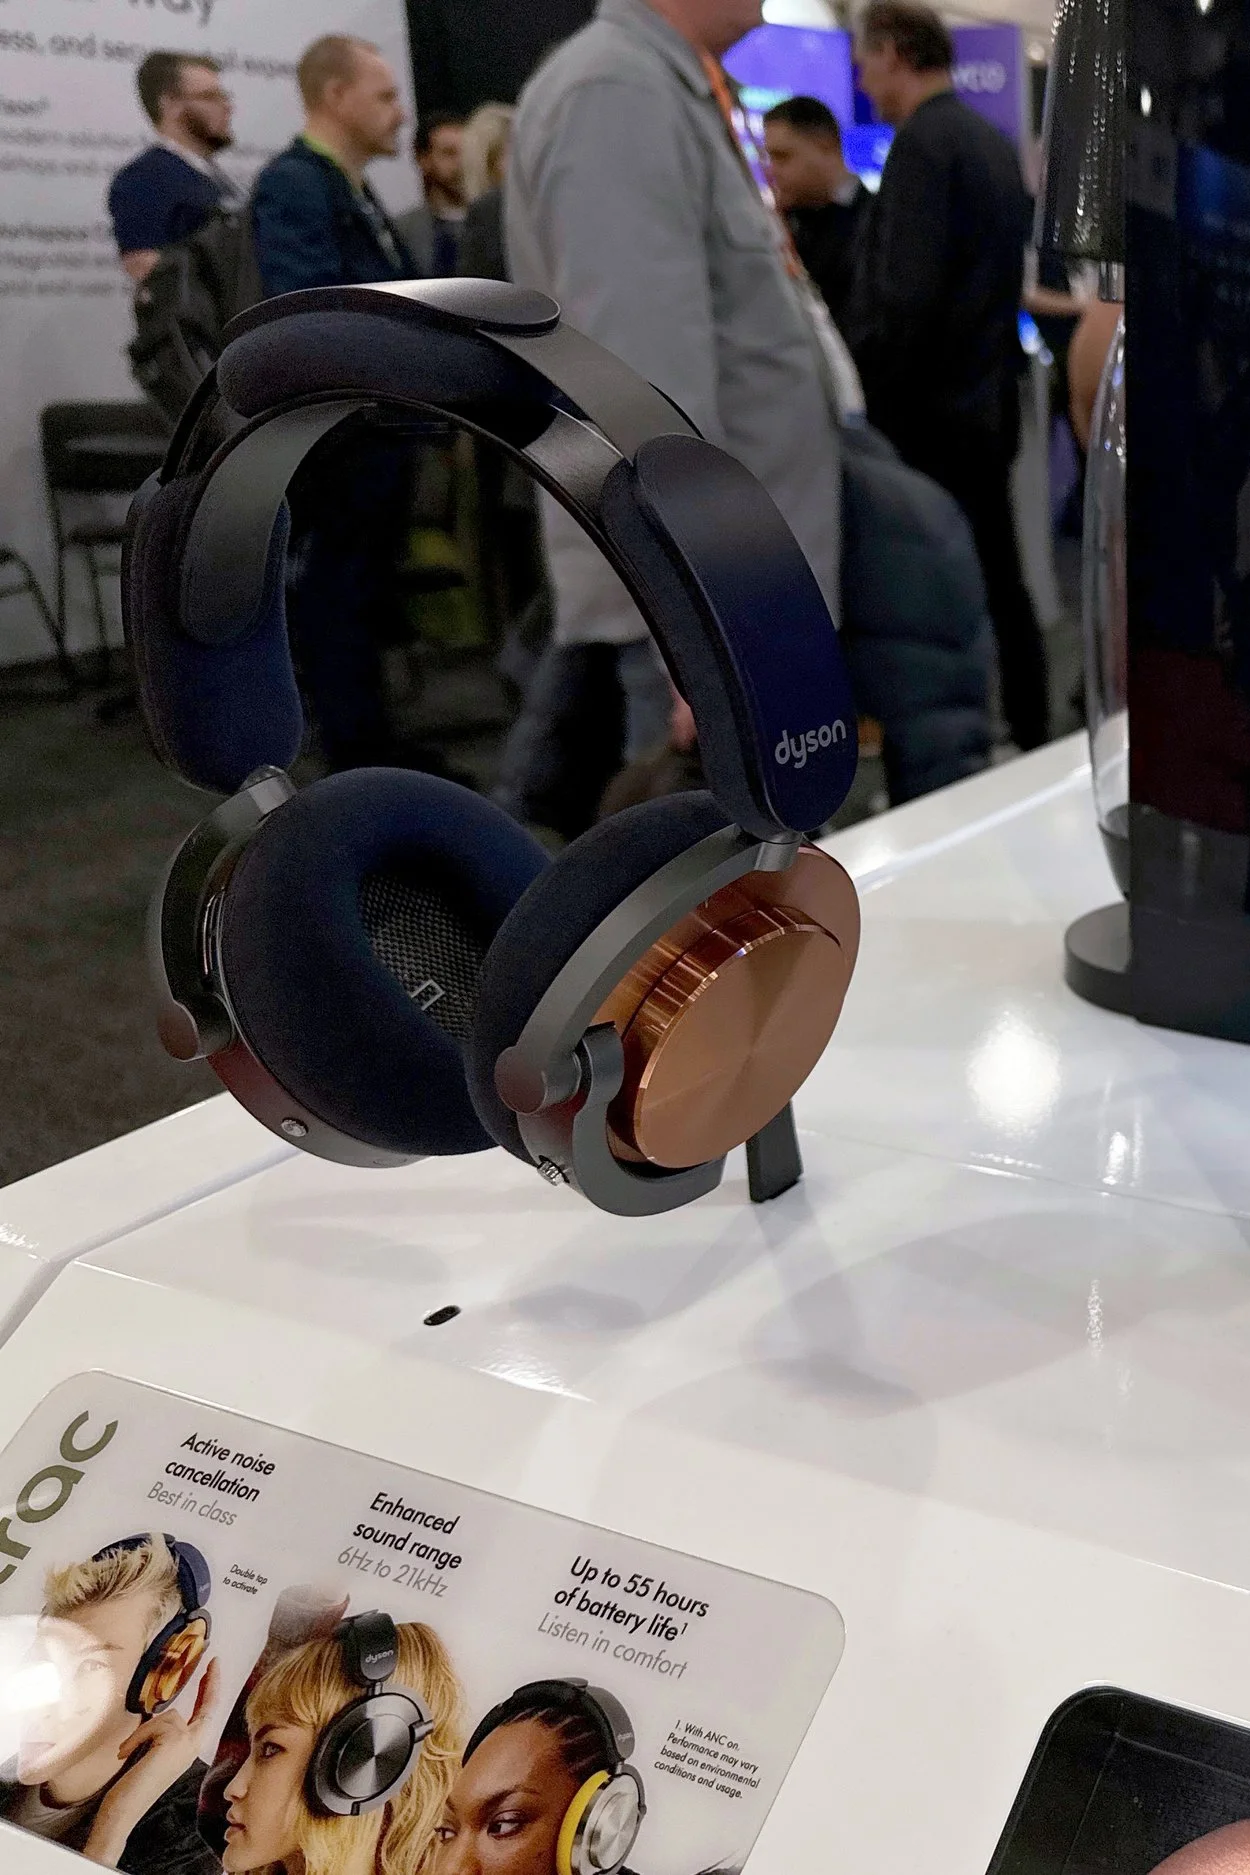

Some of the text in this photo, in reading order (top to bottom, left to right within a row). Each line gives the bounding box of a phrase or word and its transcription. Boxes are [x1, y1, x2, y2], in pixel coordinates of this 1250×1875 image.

[774, 719, 847, 769] dyson
[180, 1432, 276, 1475] Active noise
[0, 1410, 119, 1584] rac
[147, 1481, 238, 1526] Best in class
[165, 1461, 260, 1502] cancellation
[369, 1491, 461, 1535] Enhanced
[352, 1523, 463, 1570] sound range
[222, 1576, 258, 1595] to activate
[230, 1564, 268, 1586] Double tap
[337, 1546, 449, 1598] 6Hz to 21kHz
[570, 1555, 710, 1618] Up to 55 hours
[554, 1586, 581, 1607] of
[576, 1590, 648, 1634] battery
[365, 1649, 394, 1664] dyson
[537, 1612, 689, 1680] Listen in comfort
[666, 1732, 759, 1774] Performance may vary
[684, 1723, 704, 1738] With
[703, 1730, 728, 1746] ANC
[654, 1760, 743, 1799] conditions and usage.
[660, 1745, 761, 1789] based on environmental
